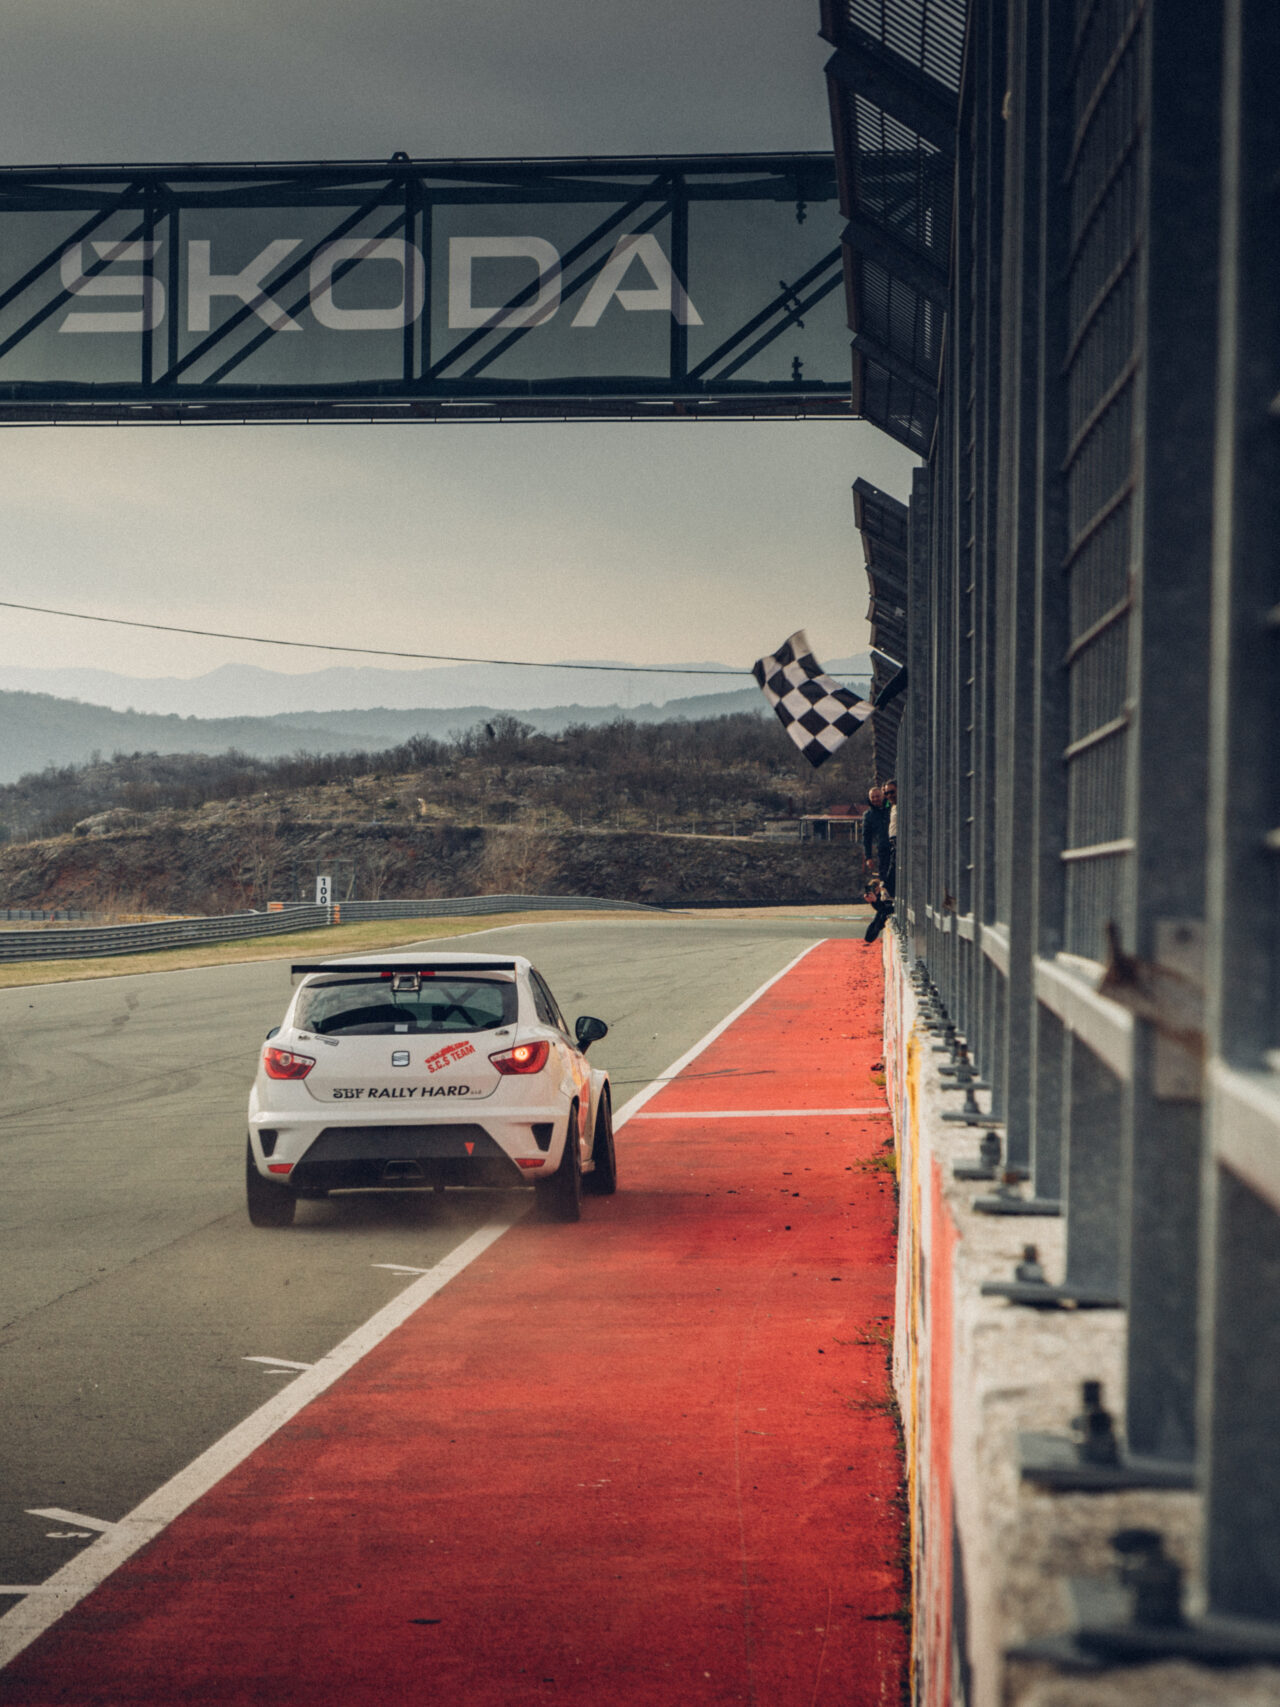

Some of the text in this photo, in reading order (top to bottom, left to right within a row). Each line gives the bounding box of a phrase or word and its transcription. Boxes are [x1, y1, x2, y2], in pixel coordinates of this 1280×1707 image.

[450, 1044, 476, 1062] TEAM
[367, 1087, 417, 1099] RALLY
[421, 1085, 470, 1097] HARD
